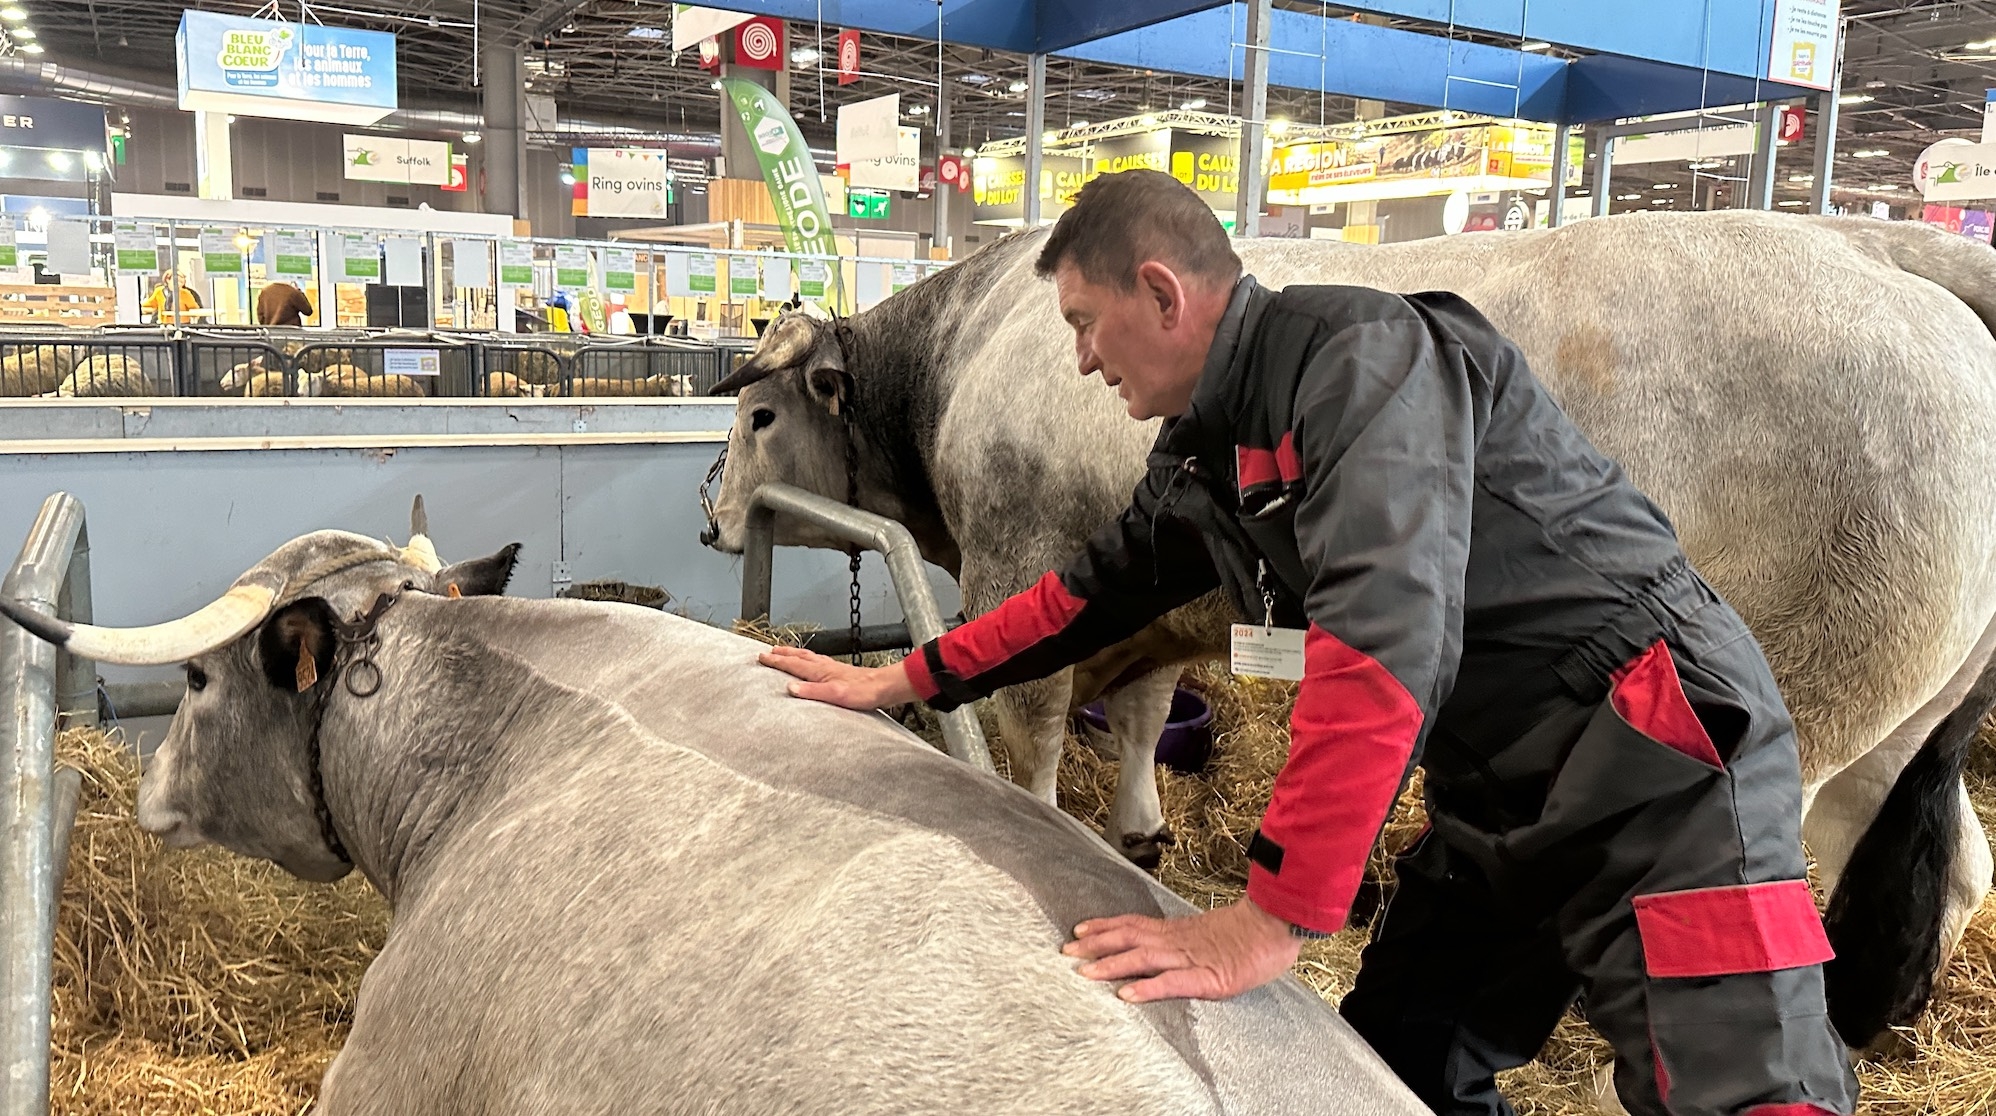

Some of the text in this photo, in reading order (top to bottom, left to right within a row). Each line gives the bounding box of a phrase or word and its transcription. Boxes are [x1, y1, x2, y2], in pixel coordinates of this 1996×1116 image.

[231, 34, 264, 44] BLEU
[227, 44, 272, 56] BLANC
[326, 44, 338, 59] la
[339, 44, 371, 61] Terre,
[223, 55, 268, 67] COEUR
[314, 60, 362, 74] animaux
[288, 72, 300, 86] et
[303, 72, 320, 87] les
[322, 74, 372, 88] hommes
[396, 156, 431, 166] Suffolk
[1976, 164, 1991, 177] Île
[592, 176, 662, 194] Ring ovins
[1196, 174, 1240, 194] DU LO
[1234, 629, 1253, 638] 2024
